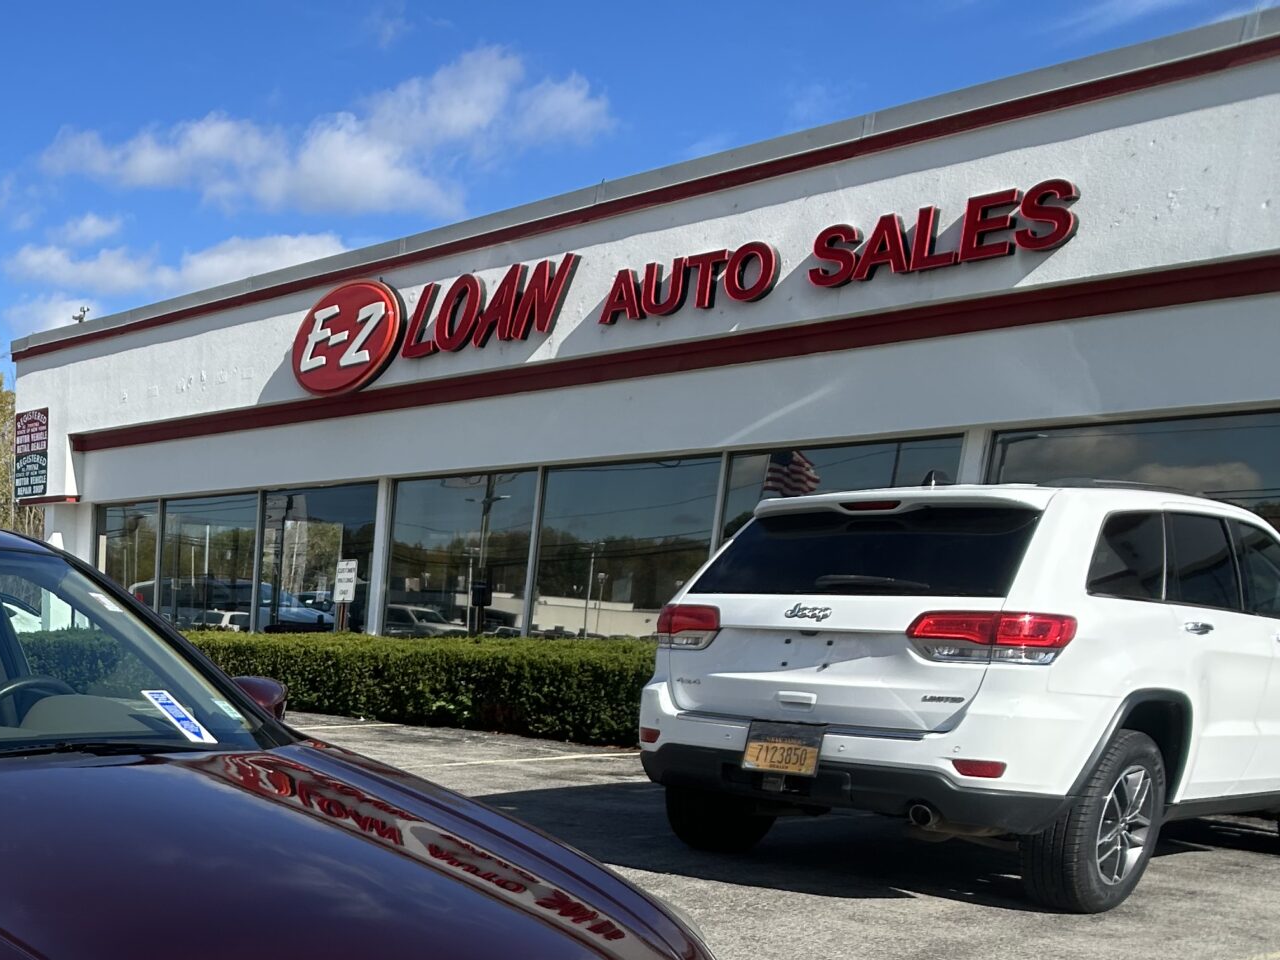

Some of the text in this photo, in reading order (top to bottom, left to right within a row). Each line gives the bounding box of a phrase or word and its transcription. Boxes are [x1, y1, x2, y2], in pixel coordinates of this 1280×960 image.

[300, 178, 1080, 373] E-Z LOAN AUTO SALES
[17, 411, 47, 429] REGISTERED
[30, 431, 47, 442] VEHICLE
[30, 441, 47, 451] DEALER
[16, 454, 47, 470] REGISTERED
[30, 475, 46, 484] VEHICLE
[17, 485, 43, 495] REPAIR SHOP
[784, 602, 832, 622] Jeep
[921, 695, 965, 703] LIMITED
[755, 744, 807, 766] 7123850
